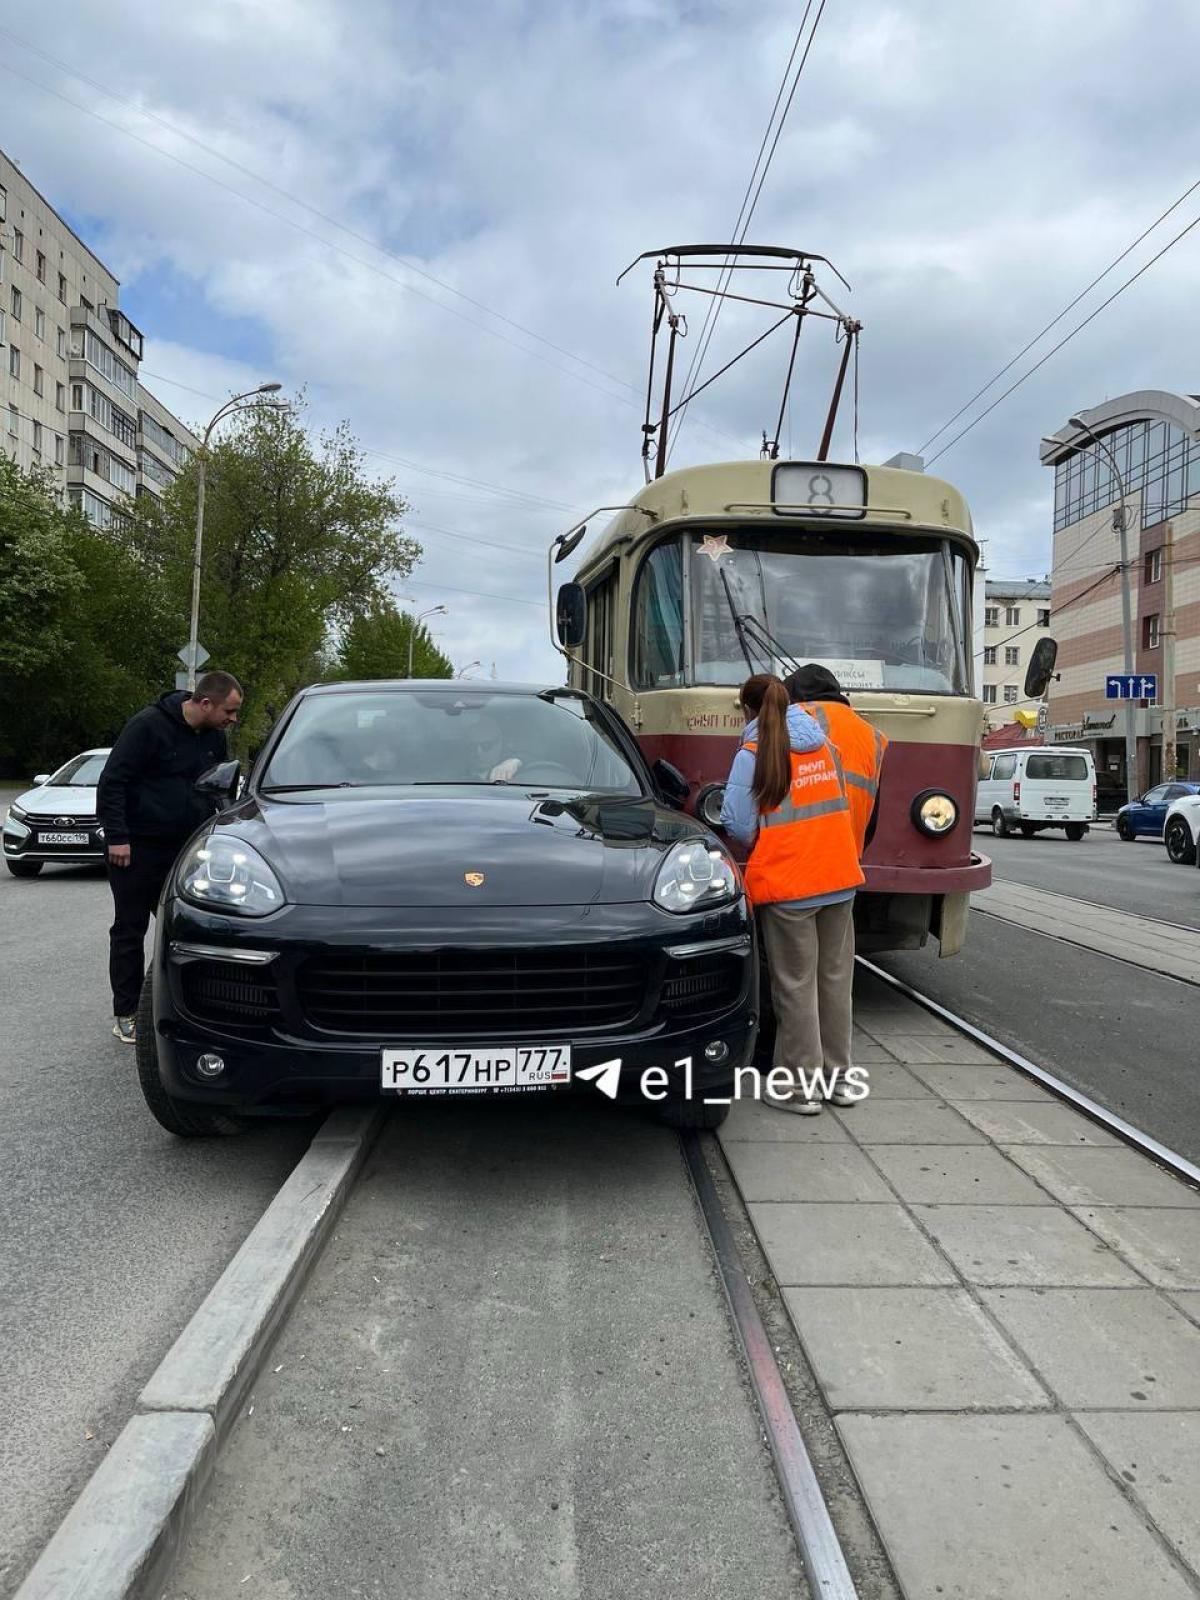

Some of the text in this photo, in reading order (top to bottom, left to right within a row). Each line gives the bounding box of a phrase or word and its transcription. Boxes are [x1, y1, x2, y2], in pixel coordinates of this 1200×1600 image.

[808, 474, 836, 515] 8
[799, 760, 826, 776] ЕМУП
[392, 1049, 563, 1084] Р617НР 777
[529, 1072, 551, 1081] RUS
